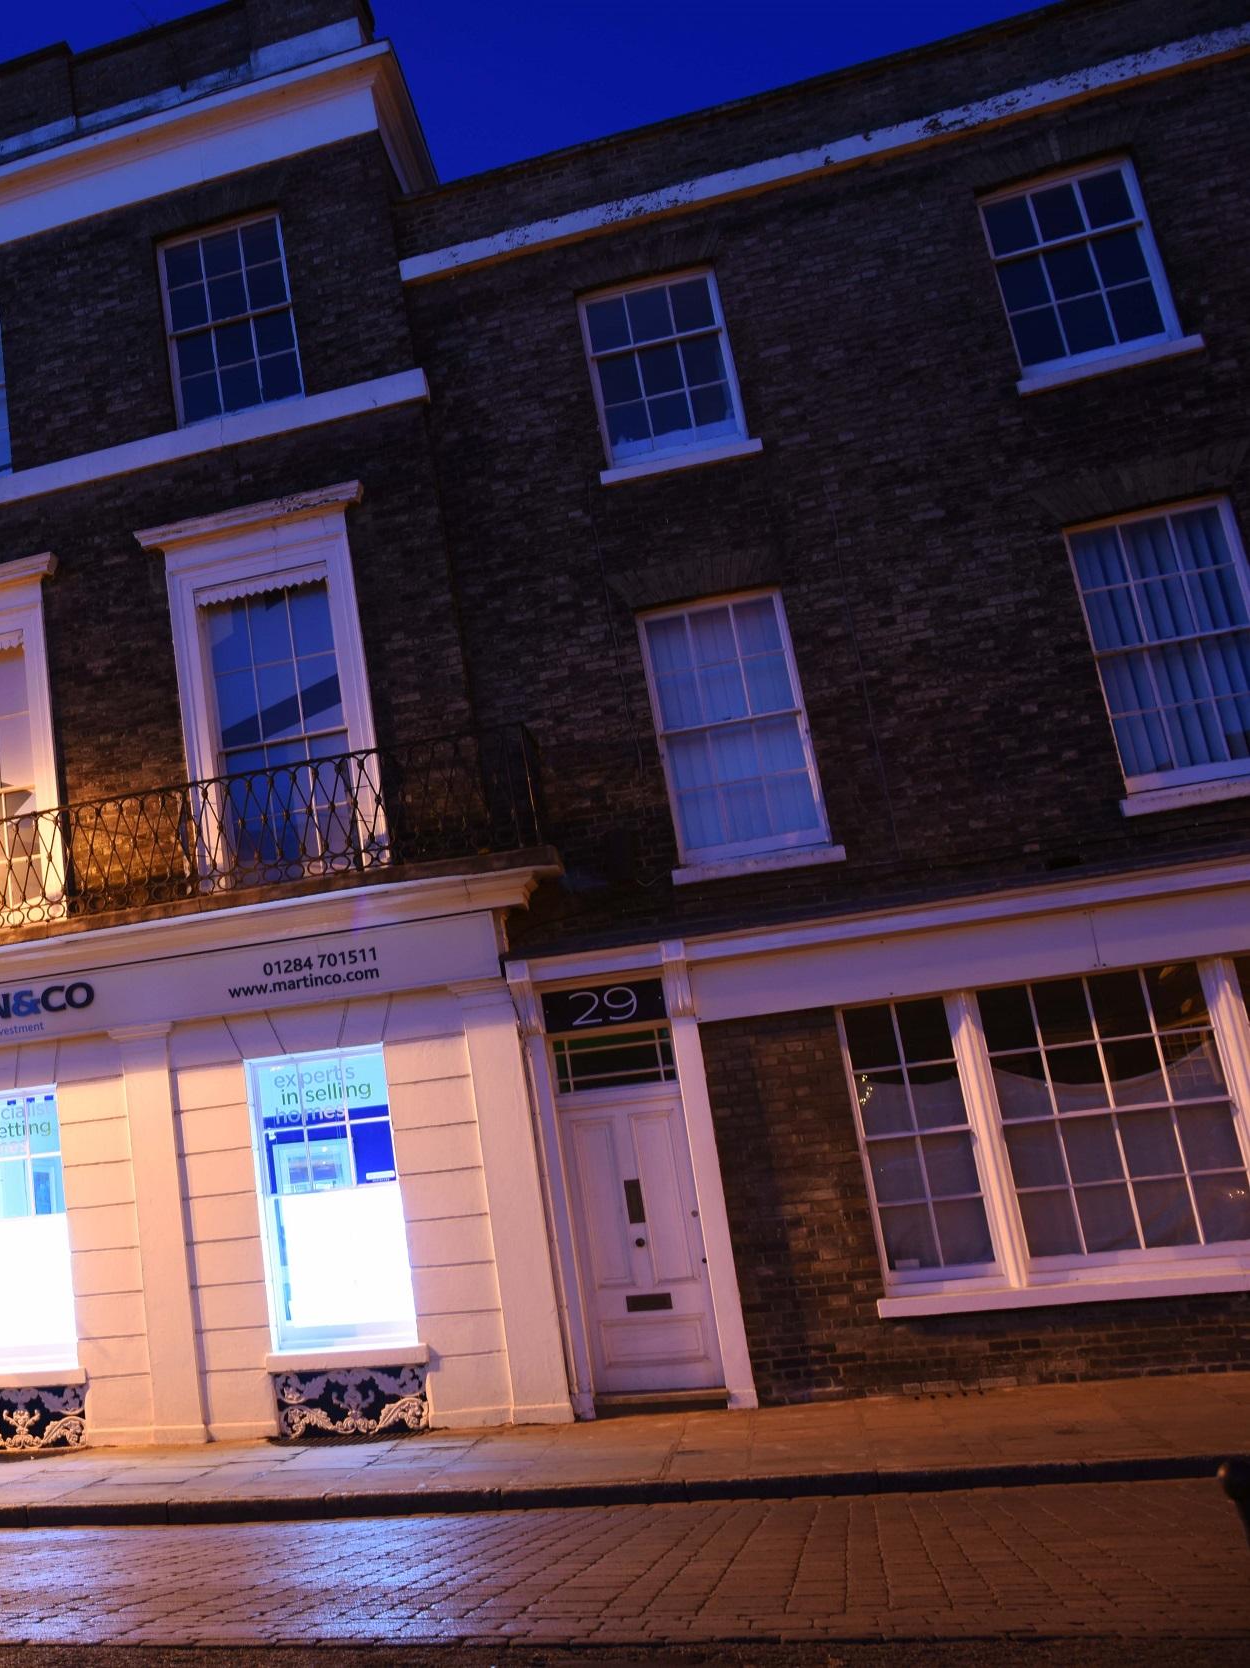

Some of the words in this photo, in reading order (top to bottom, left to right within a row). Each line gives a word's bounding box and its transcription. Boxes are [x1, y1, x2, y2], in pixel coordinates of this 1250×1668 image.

[263, 956, 313, 976] 01284
[317, 946, 377, 969] 701511
[228, 967, 380, 998] www.martinco.com
[568, 986, 638, 1026] 29
[274, 1065, 355, 1089] experts
[281, 1088, 299, 1106] in
[305, 1081, 372, 1103] selling
[275, 1104, 345, 1125] homes
